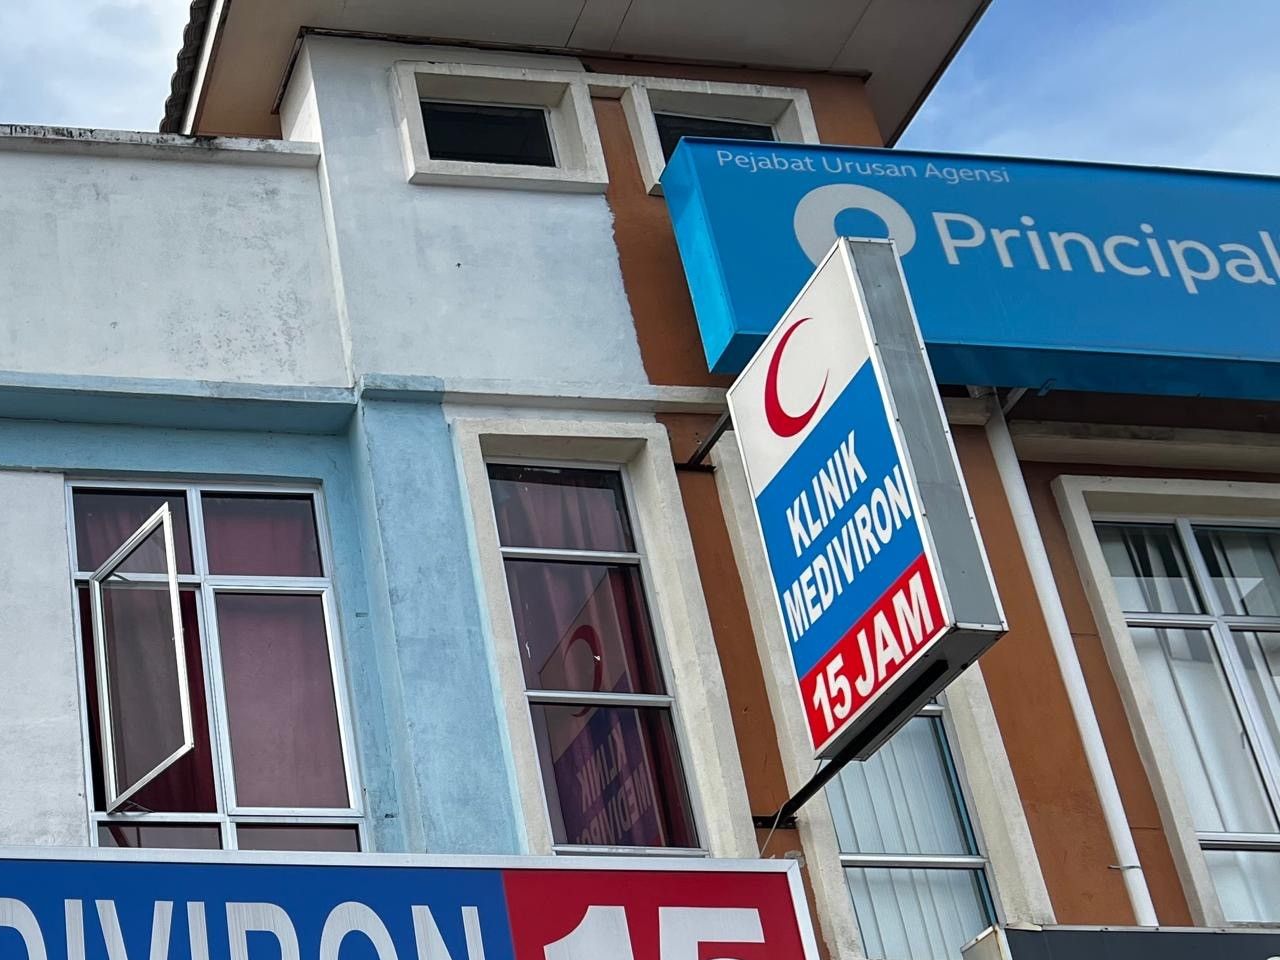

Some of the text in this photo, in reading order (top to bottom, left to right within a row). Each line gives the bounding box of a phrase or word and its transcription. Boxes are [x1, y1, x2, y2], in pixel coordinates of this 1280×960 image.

[716, 150, 1011, 185] Pejabat Urusan Agensi
[931, 211, 1280, 295] Principal
[782, 463, 912, 643] MEDIVIRON
[786, 429, 868, 558] KLINIK
[812, 570, 935, 733] 15 JAM
